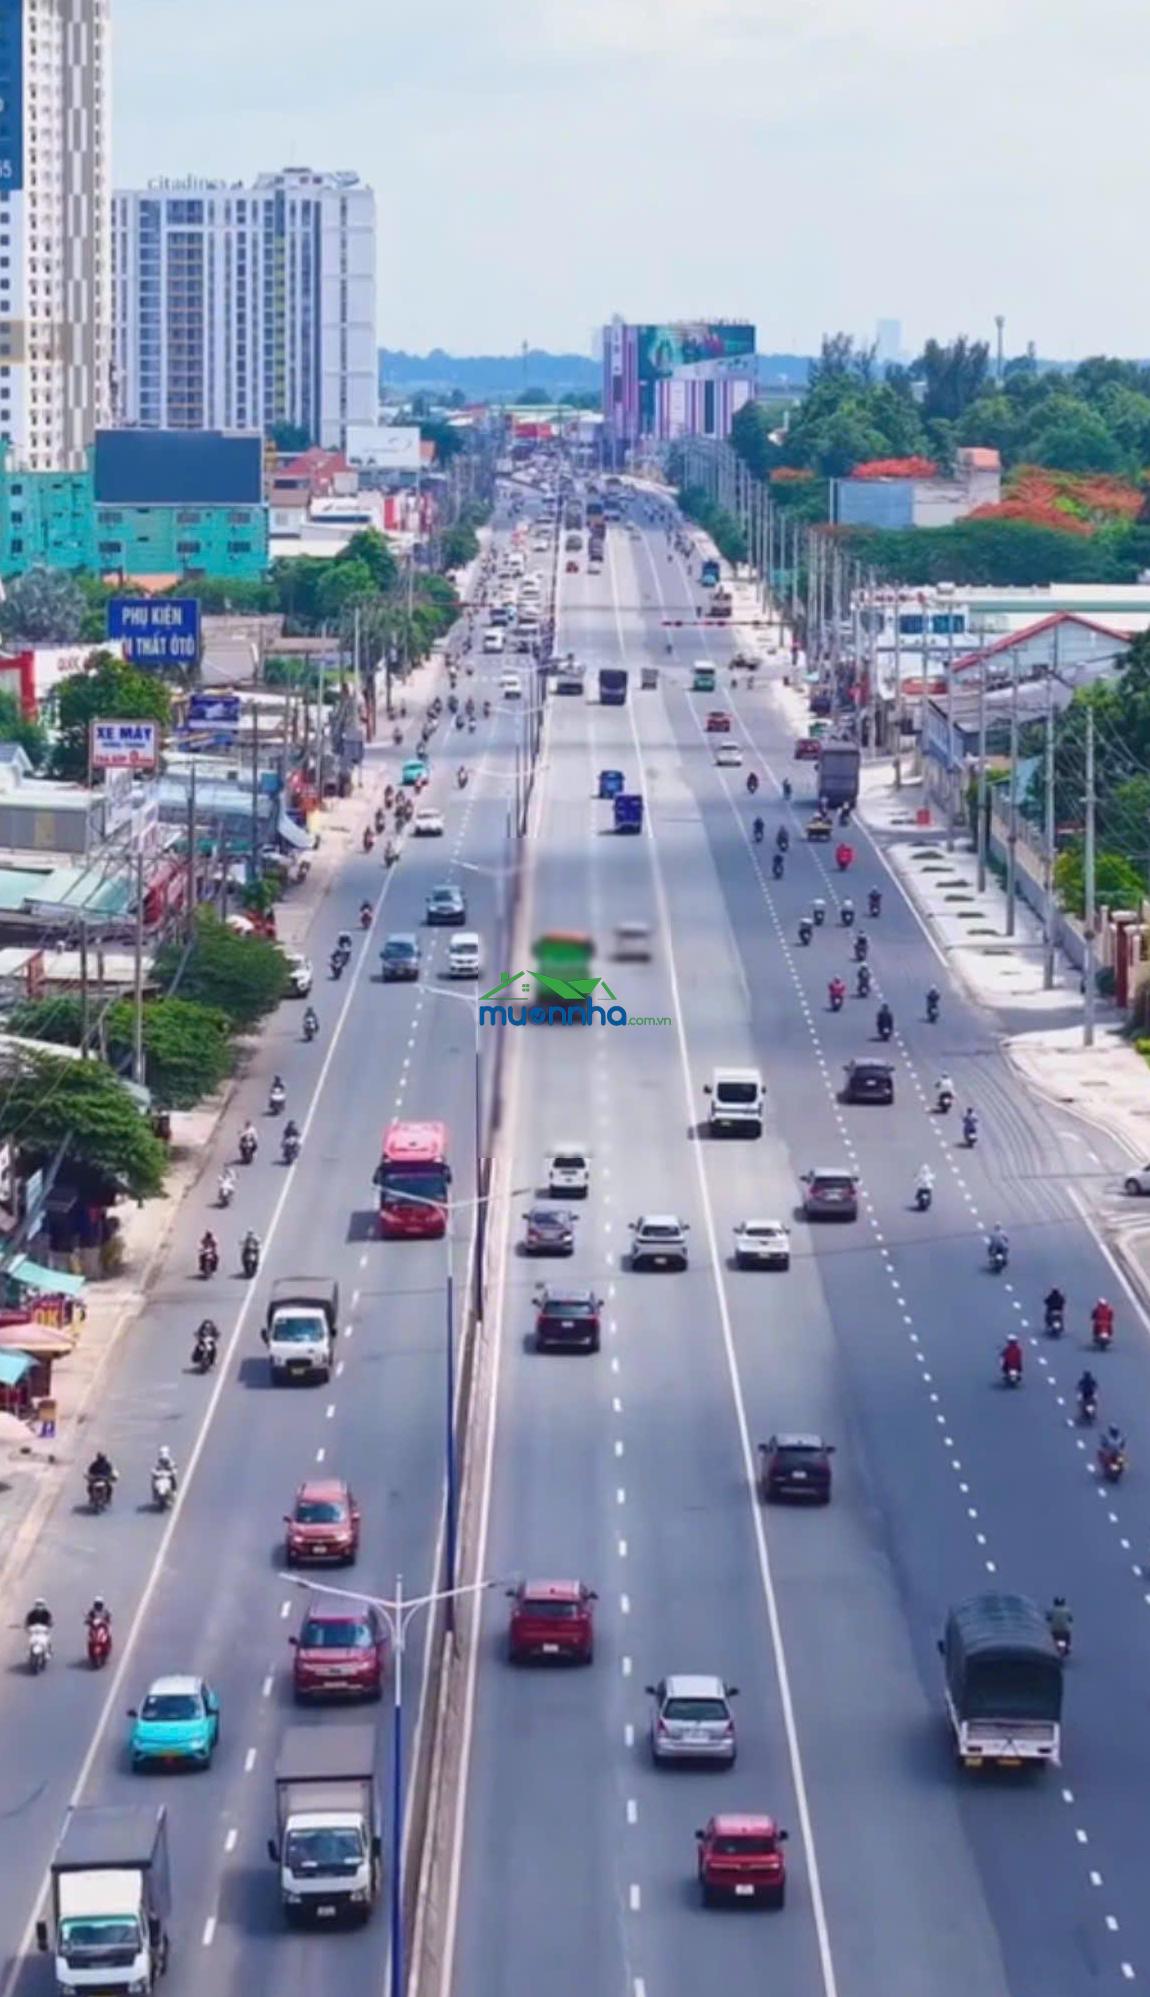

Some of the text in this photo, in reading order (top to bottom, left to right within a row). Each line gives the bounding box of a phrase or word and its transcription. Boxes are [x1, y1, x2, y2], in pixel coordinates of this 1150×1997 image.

[121, 603, 182, 629] PHỤ KIỆN
[96, 725, 151, 740] XE MÁY
